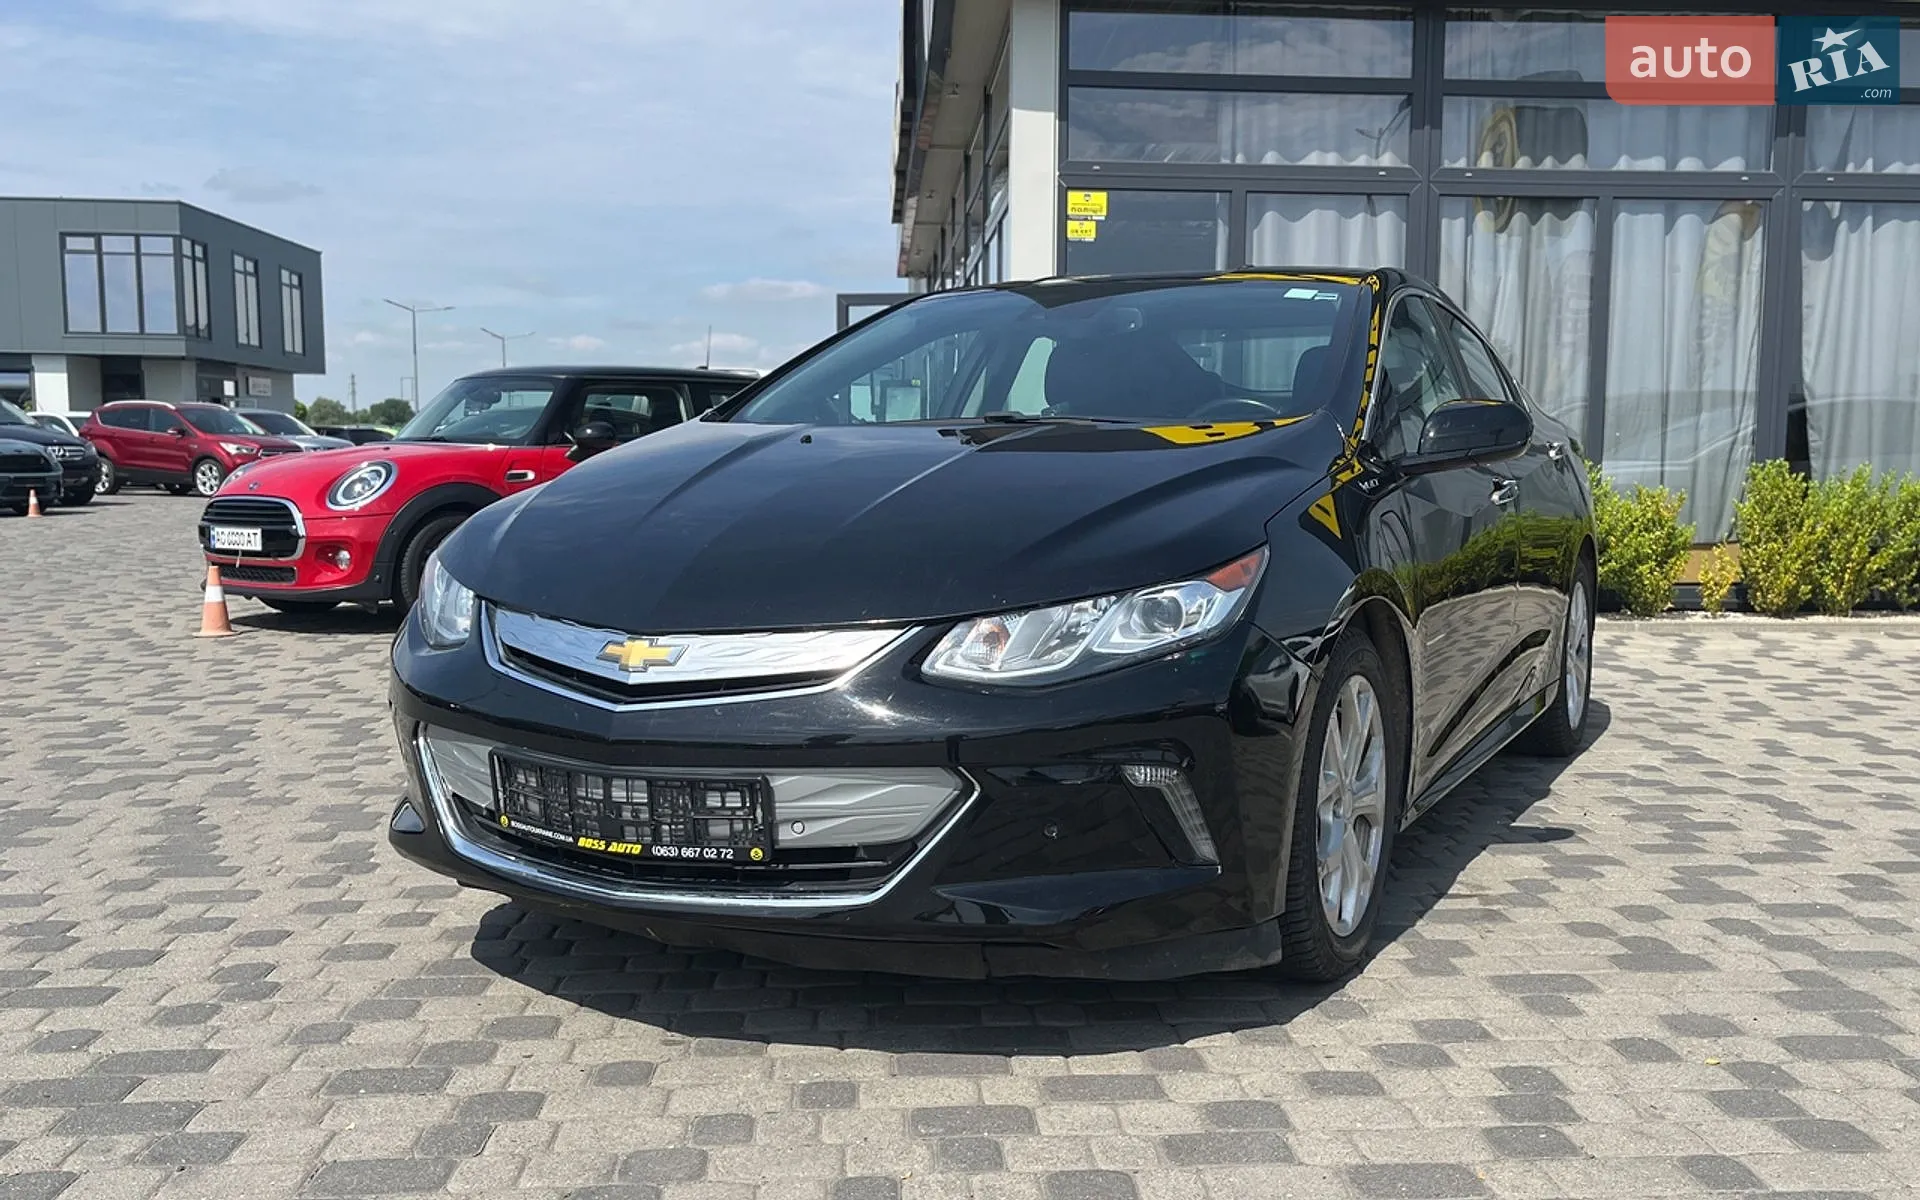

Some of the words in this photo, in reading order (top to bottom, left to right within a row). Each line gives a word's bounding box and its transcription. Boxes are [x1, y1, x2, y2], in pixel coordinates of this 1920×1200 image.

[577, 836, 606, 851] BOSS
[607, 841, 643, 855] AUTO
[651, 845, 679, 858] (063)
[681, 847, 701, 859] 667
[703, 848, 718, 859] 02
[720, 848, 734, 860] 72
